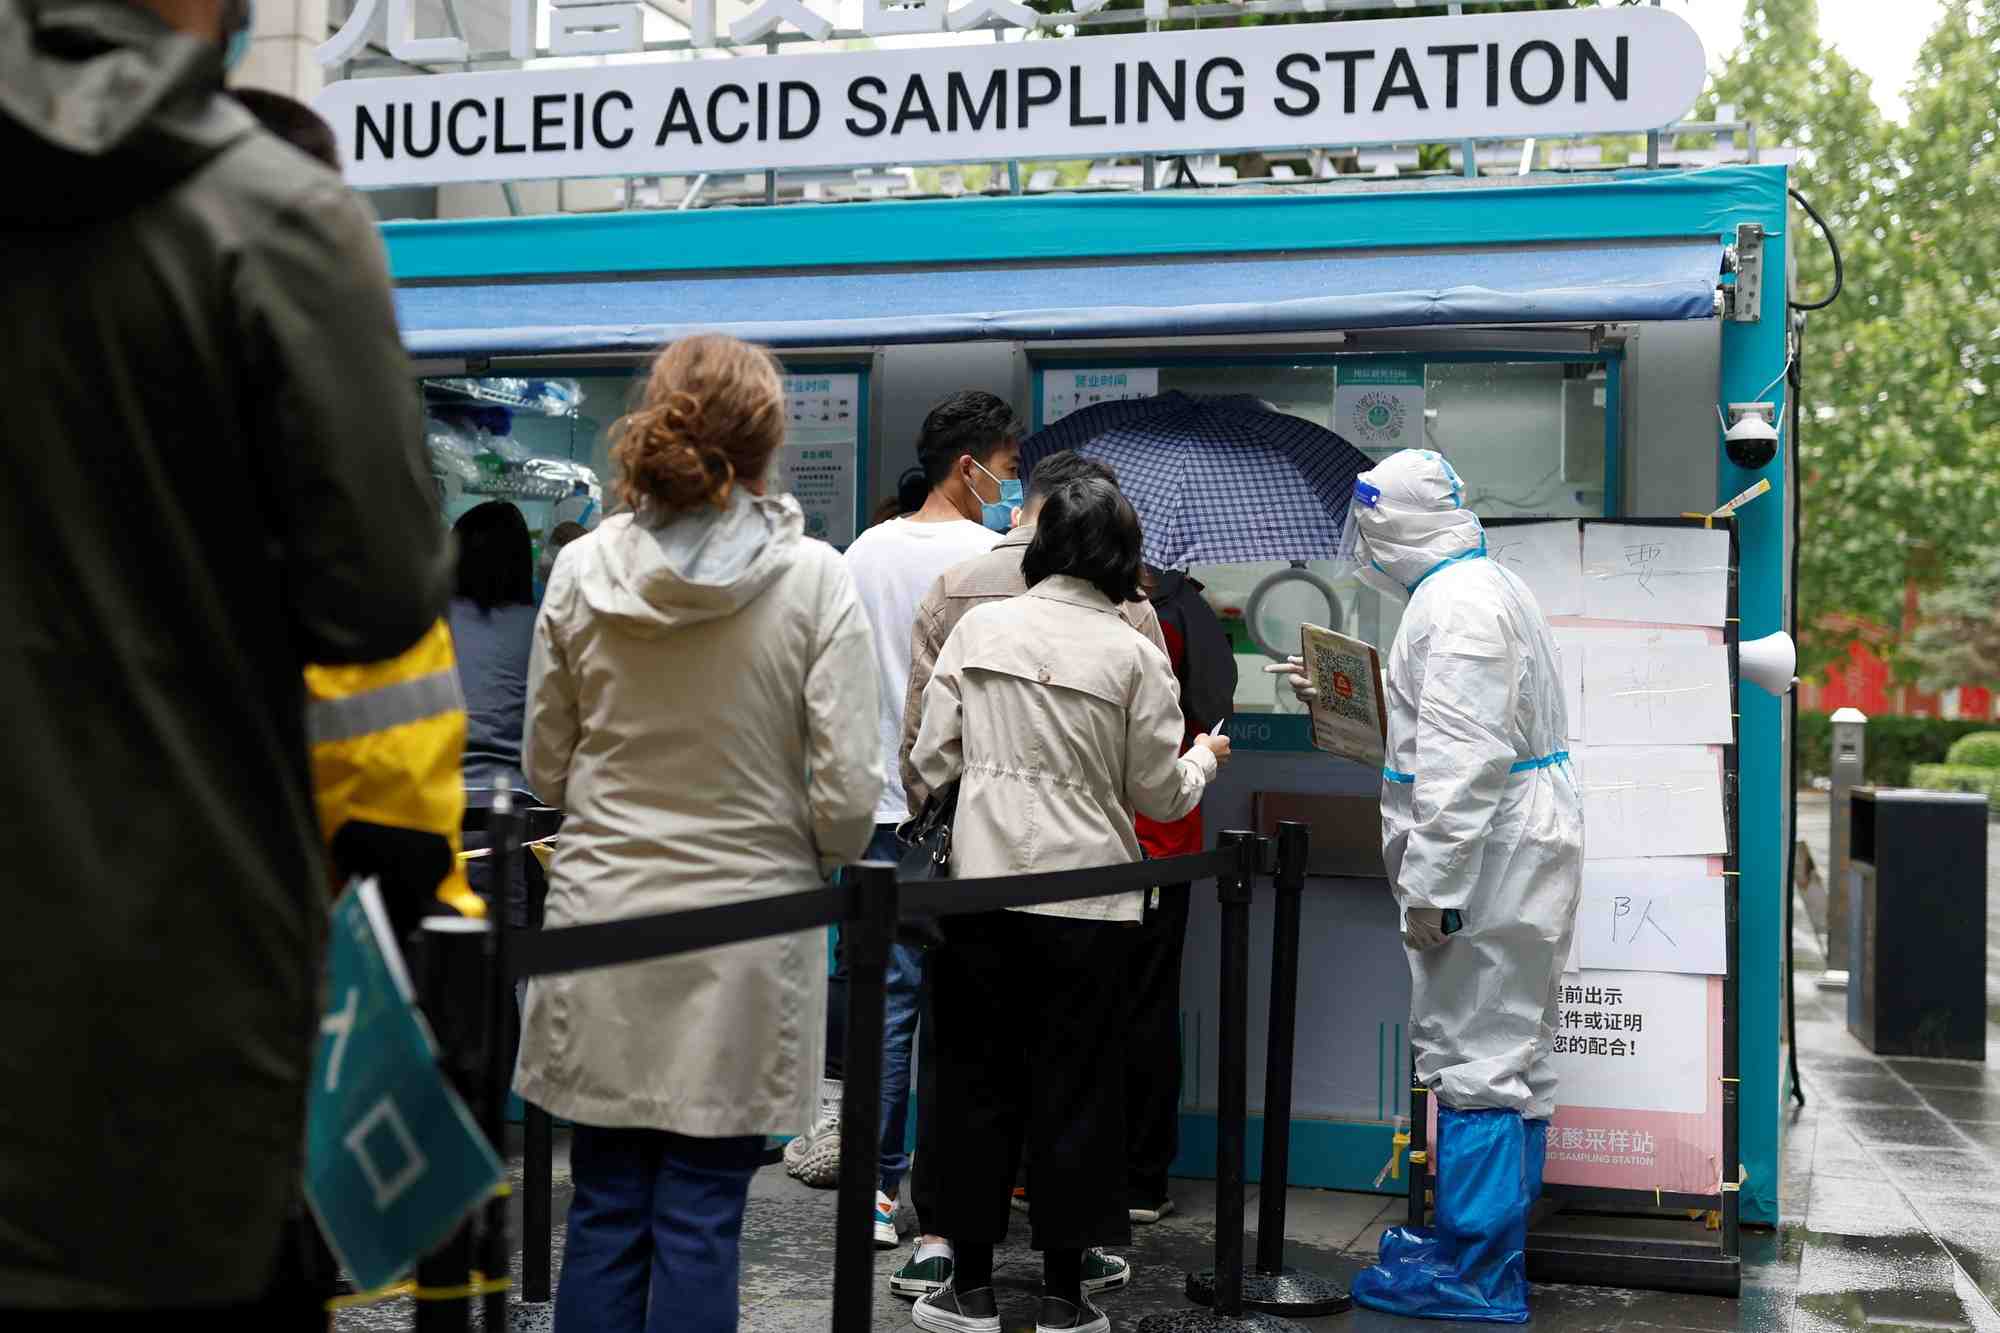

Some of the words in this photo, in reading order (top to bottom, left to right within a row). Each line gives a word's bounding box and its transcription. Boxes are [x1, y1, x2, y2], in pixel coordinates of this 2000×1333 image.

[355, 90, 634, 161] NUCLEIC
[655, 80, 821, 147] ACID
[845, 56, 1245, 138] SAMPLING
[1273, 35, 1629, 117] STATION
[1560, 1010, 1643, 1032] 件或证明
[1612, 1154, 1655, 1168] STATION
